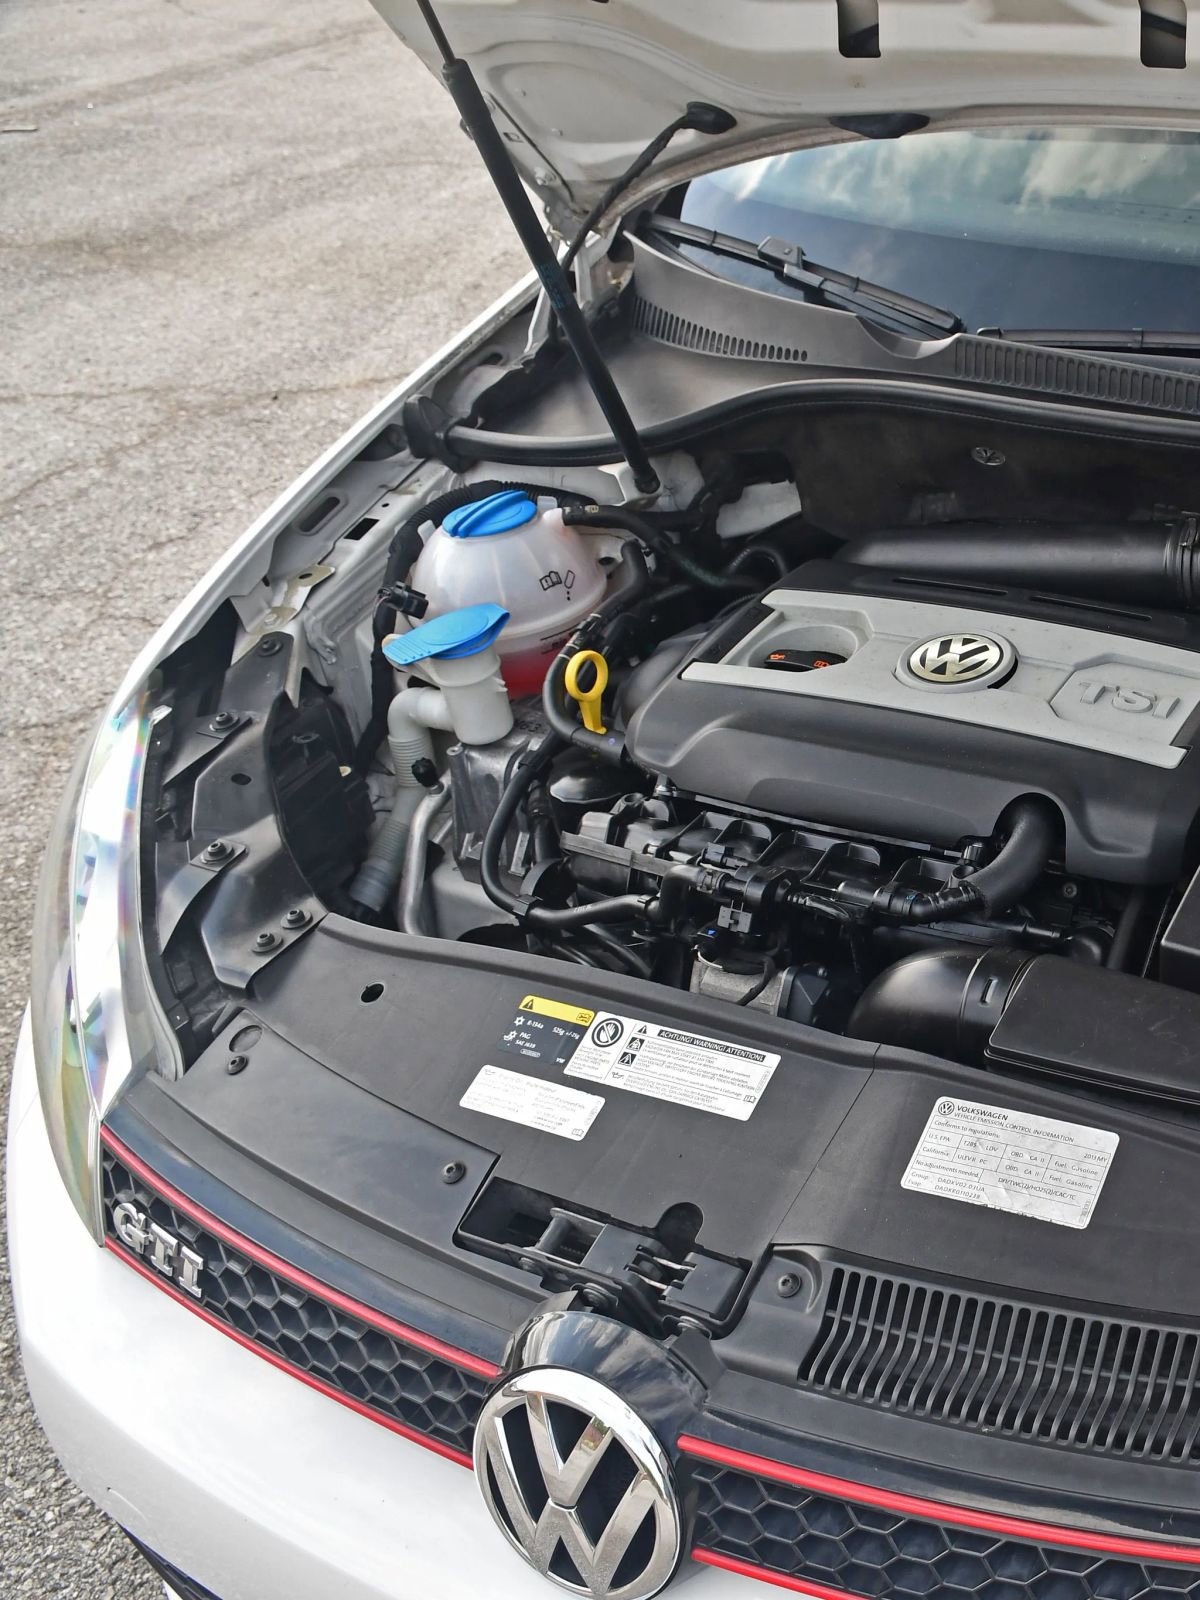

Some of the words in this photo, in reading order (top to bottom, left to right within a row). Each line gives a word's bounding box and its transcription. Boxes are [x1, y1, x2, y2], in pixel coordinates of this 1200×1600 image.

[1079, 681, 1180, 719] TSI
[660, 1031, 693, 1043] ACHTUNG!
[693, 1039, 725, 1052] WARNING!
[726, 1047, 764, 1061] ATTENTION!
[957, 1105, 1008, 1121] VOLKSWAGEN
[976, 1116, 1004, 1126] EMISSION
[1004, 1122, 1031, 1132] CONTROL
[1032, 1128, 1075, 1142] INFORMATION
[1065, 1178, 1093, 1190] Gasoline
[113, 1203, 204, 1298] GTI
